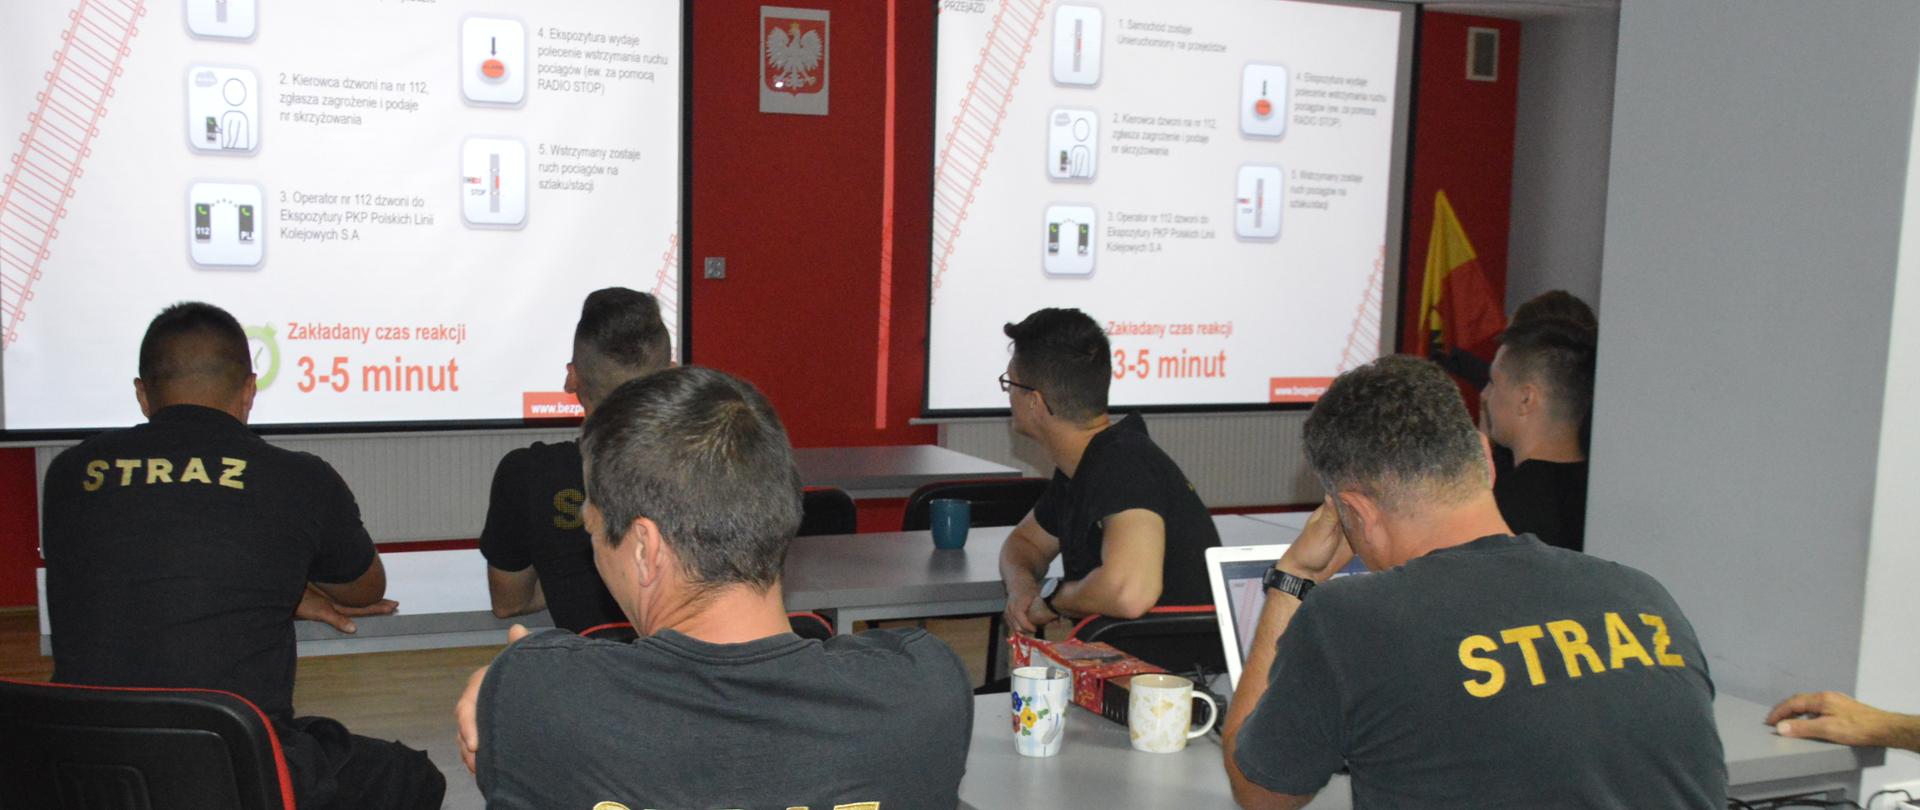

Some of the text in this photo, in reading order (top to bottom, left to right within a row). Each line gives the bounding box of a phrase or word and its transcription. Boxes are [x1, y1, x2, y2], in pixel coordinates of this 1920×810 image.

[549, 28, 606, 44] Ekspozytura
[608, 34, 640, 48] wydaje
[537, 46, 669, 66] polecenie wstrzymania ruchu
[292, 73, 340, 88] Kierowca
[342, 77, 378, 91] dzwoni
[380, 81, 393, 92] na
[396, 82, 406, 92] nr
[605, 68, 616, 78] za
[619, 68, 655, 83] pomocą
[537, 78, 606, 96] RADIO STOP)
[280, 92, 319, 107] zgłasza
[322, 95, 377, 109] zagrożenie
[386, 98, 419, 113] podaje
[280, 111, 362, 126] nr skrzyżowania
[550, 144, 606, 160] Wstrzymany
[608, 148, 640, 162] zostaje
[538, 162, 559, 174] ruch
[606, 166, 619, 176] na
[292, 190, 338, 206] Operator
[340, 194, 350, 204] nr
[354, 194, 372, 206] 112
[375, 194, 410, 208] dzwoni
[412, 196, 424, 208] do
[280, 208, 434, 225] Ekspozytury PKP Polskich Linii
[196, 226, 210, 236] 112
[280, 228, 338, 242] Kolejowych
[287, 322, 467, 345] Zakładany czas reakcji
[1106, 320, 1233, 338] Zakładany czas reakcji
[1112, 348, 1226, 380] 3-5 minut
[297, 356, 460, 393] 3-5 minut
